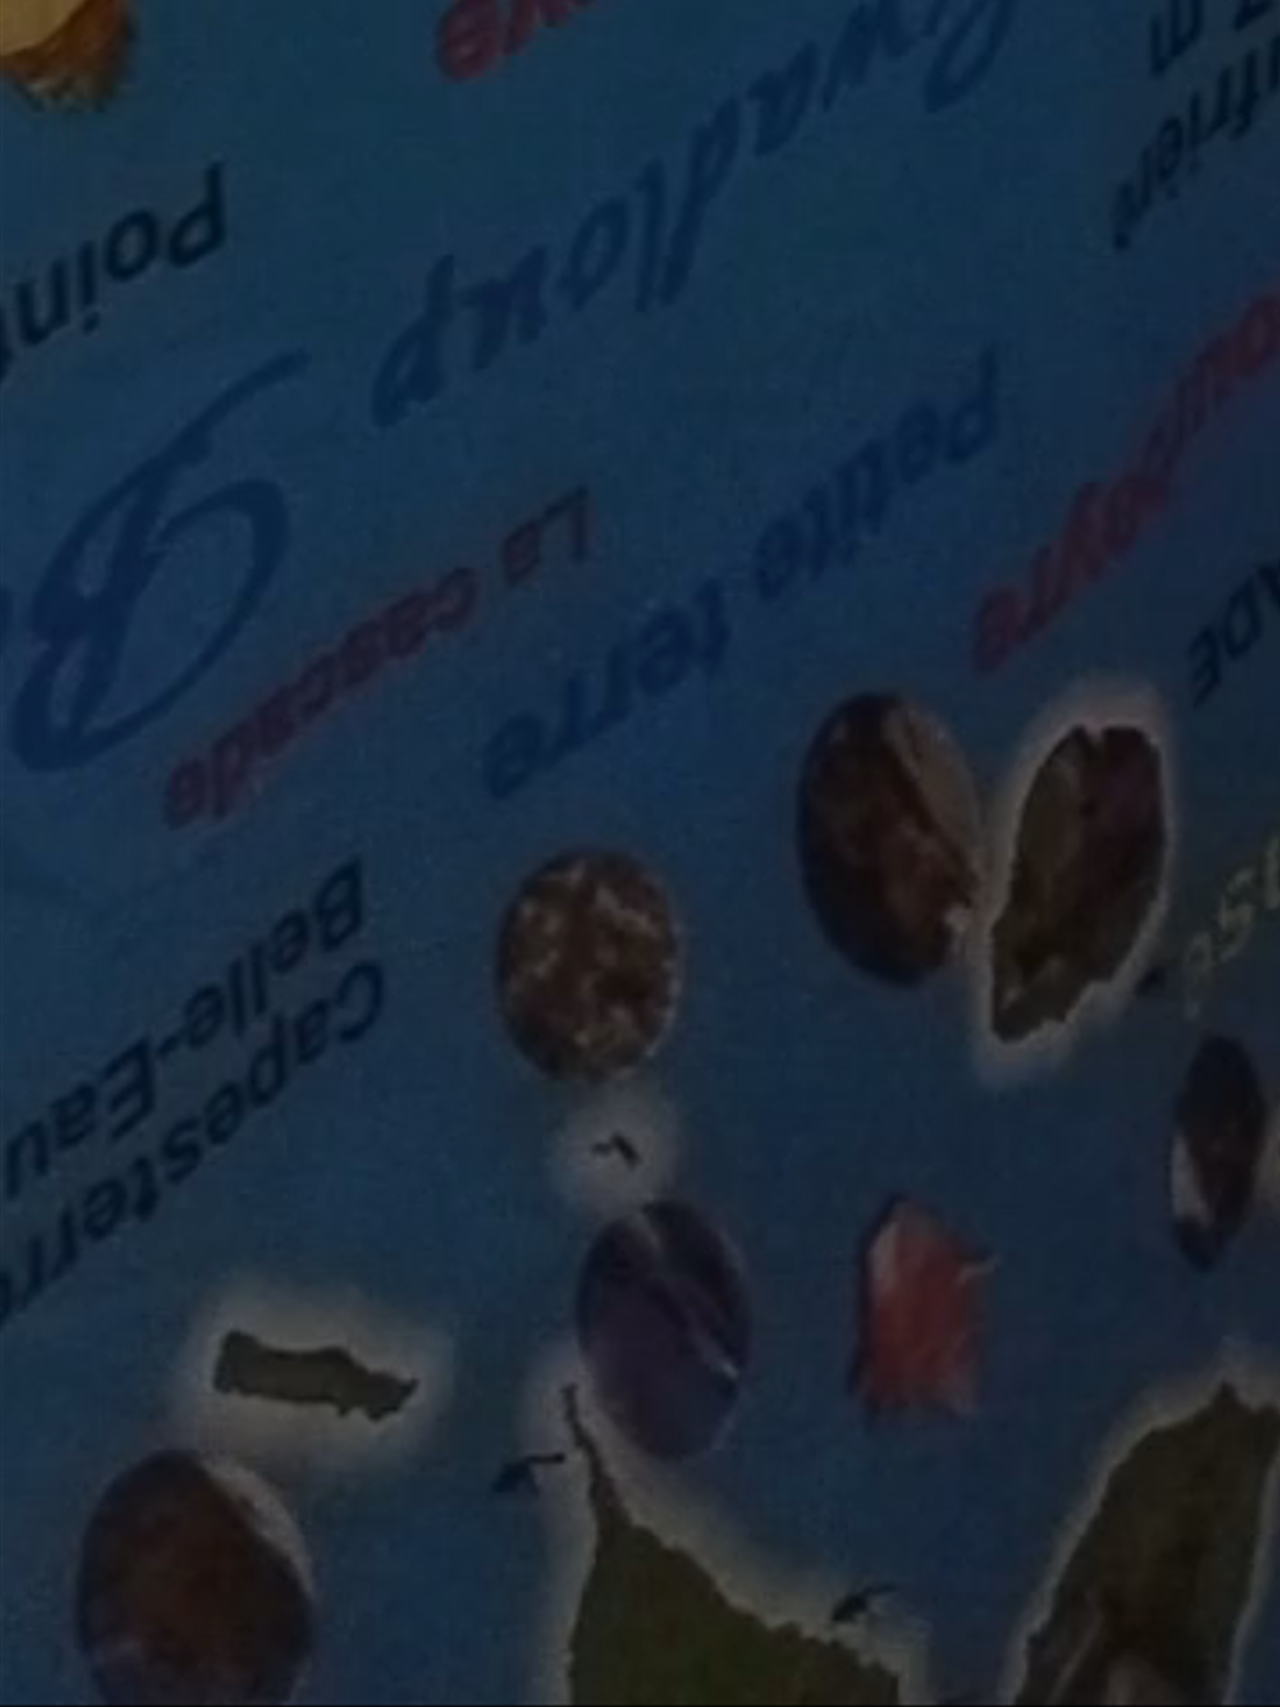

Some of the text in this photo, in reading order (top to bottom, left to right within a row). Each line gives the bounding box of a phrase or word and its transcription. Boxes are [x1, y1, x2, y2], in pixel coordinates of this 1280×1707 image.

[480, 347, 1001, 797] Petite terre
[7, 857, 362, 1198] Belle-Eau
